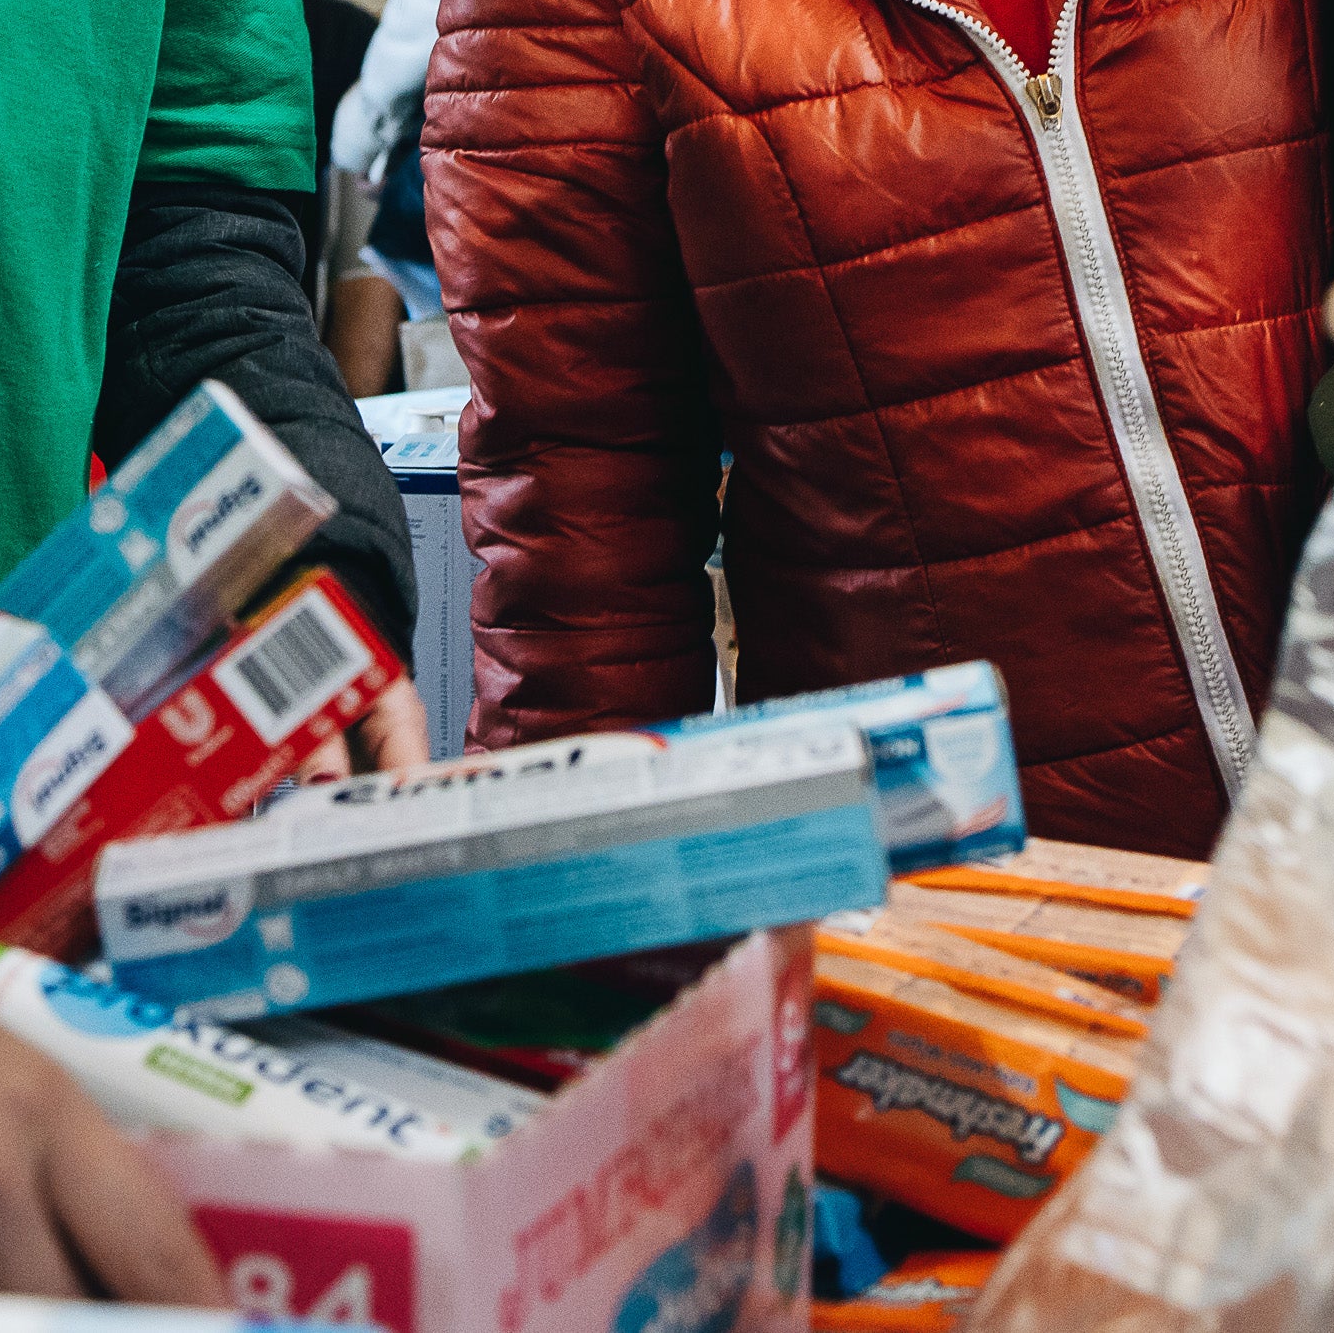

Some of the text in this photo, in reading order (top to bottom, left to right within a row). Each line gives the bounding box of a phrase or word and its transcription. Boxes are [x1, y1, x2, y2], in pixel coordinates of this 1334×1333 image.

[185, 473, 262, 553] Signal
[34, 730, 109, 805] Signal
[124, 889, 228, 931] Signal
